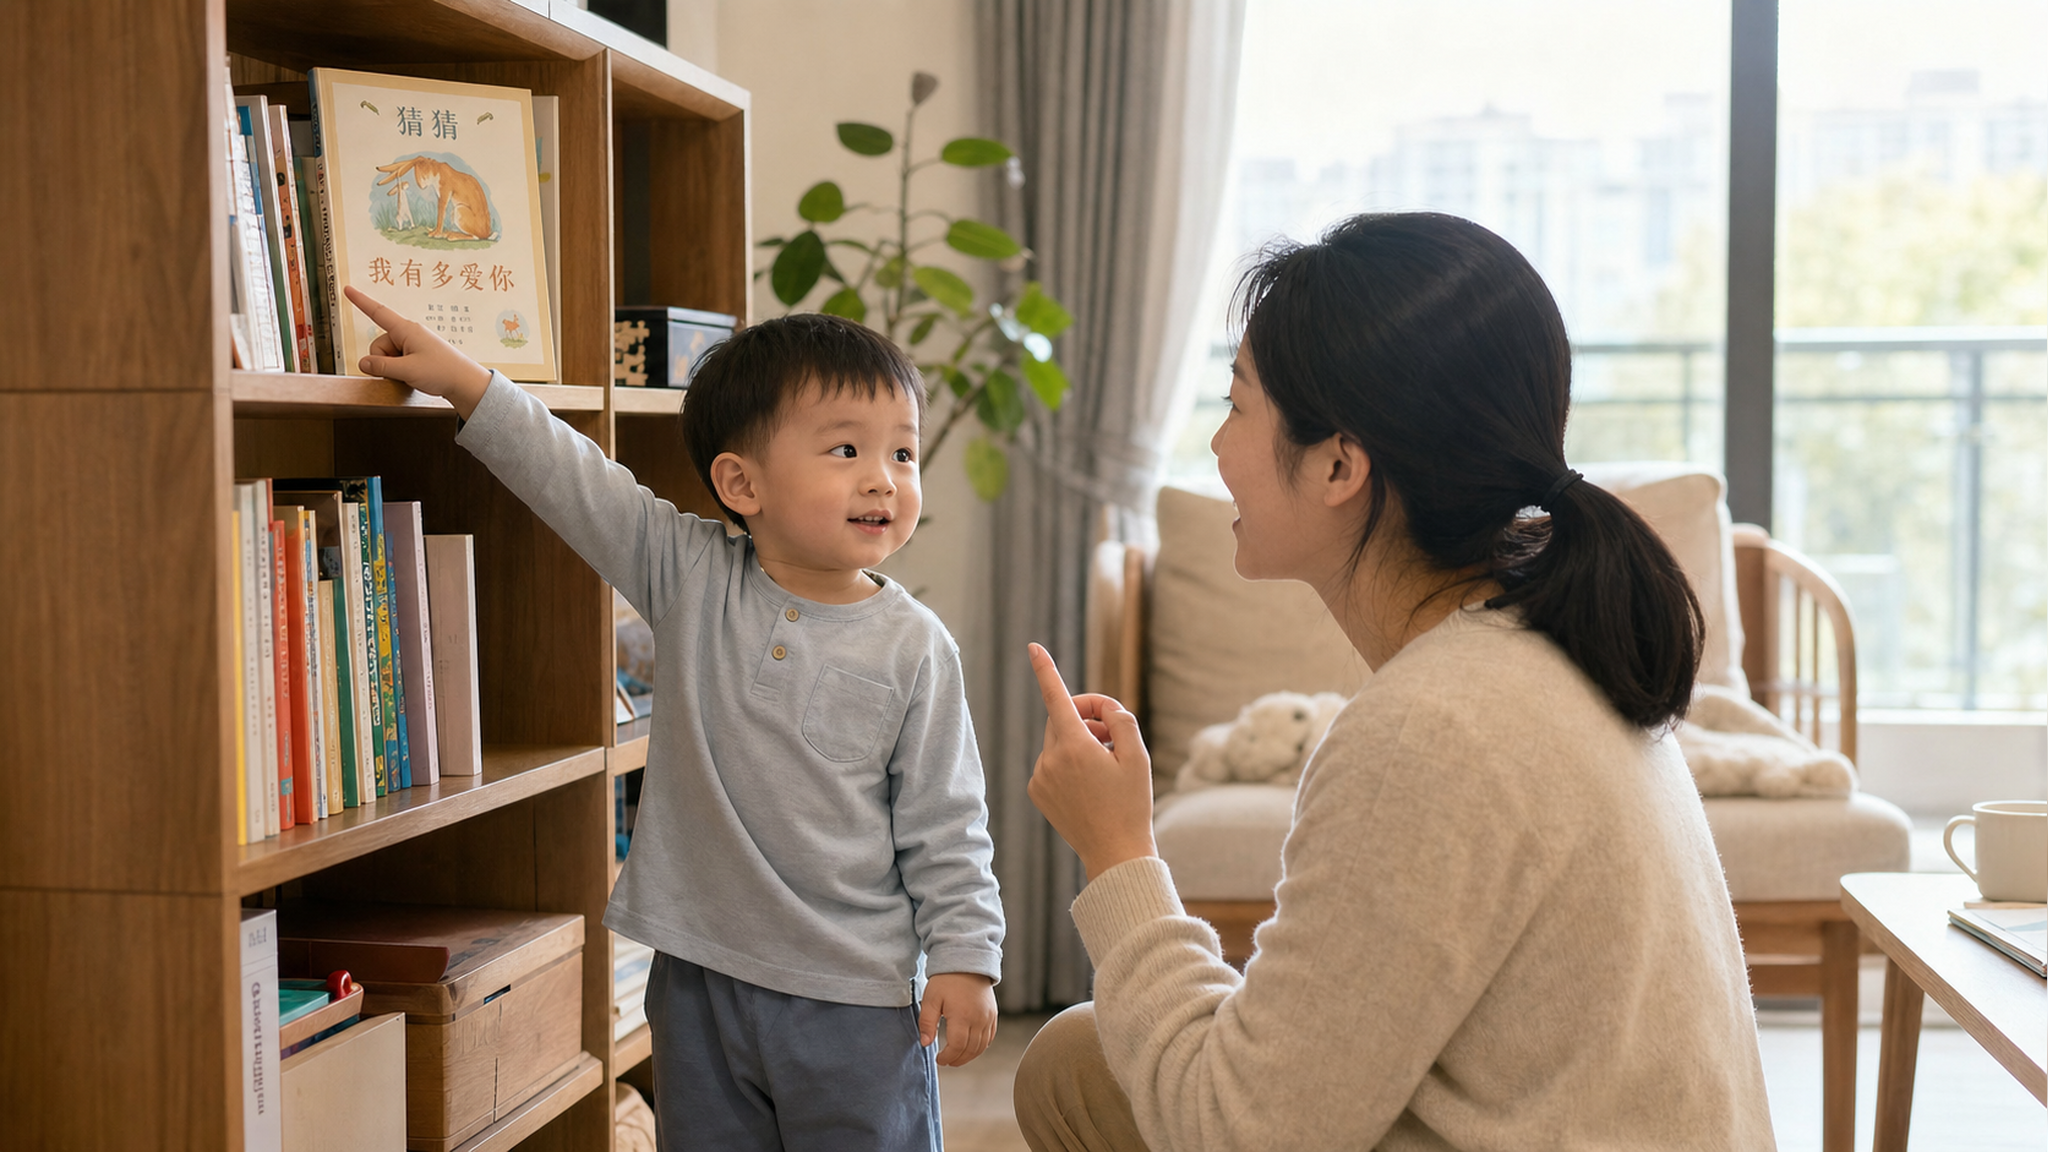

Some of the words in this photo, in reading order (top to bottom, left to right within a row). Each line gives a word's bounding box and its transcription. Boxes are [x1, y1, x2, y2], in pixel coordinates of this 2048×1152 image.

[396, 106, 459, 141] 猜猜
[368, 256, 515, 293] 我有多爱你
